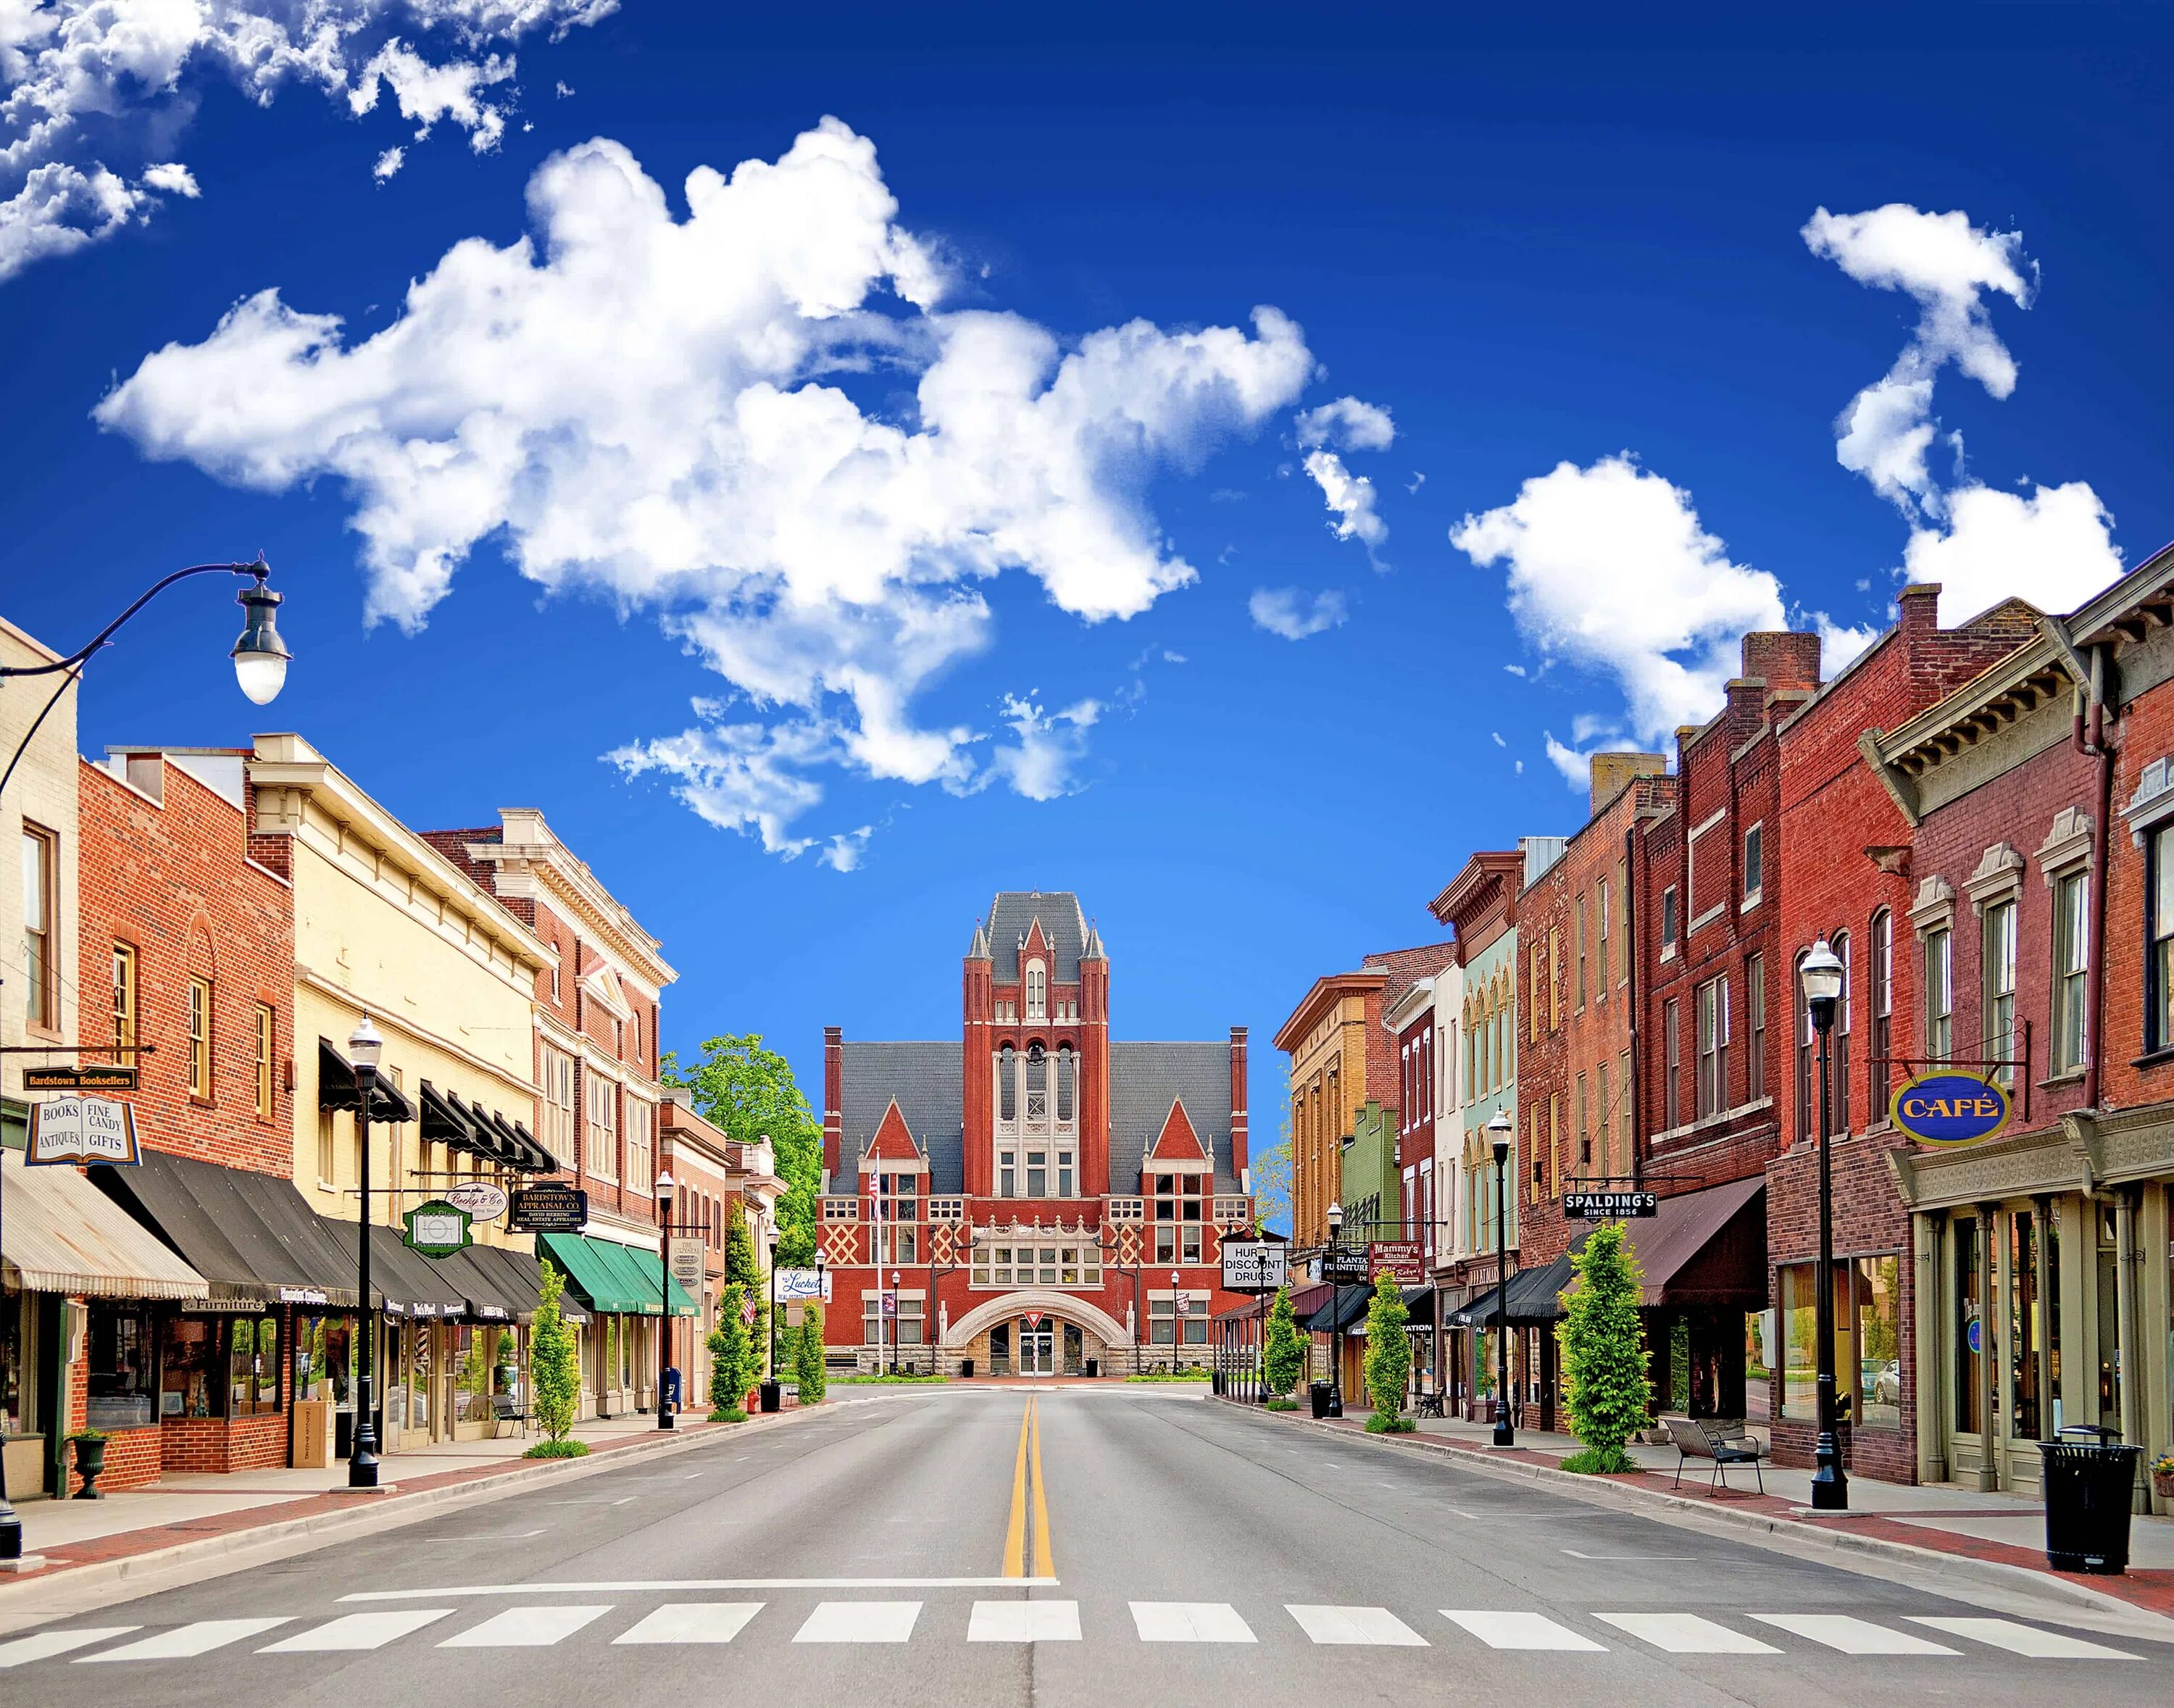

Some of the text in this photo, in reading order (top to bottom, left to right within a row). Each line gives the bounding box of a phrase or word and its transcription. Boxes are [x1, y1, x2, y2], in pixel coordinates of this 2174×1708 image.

[29, 1076, 130, 1086] Bardstown Booksellers
[43, 1104, 79, 1121] BOOKS
[88, 1104, 111, 1118] FINE
[1904, 1093, 1999, 1118] CAFÉ
[89, 1115, 122, 1131] CANDY
[39, 1131, 81, 1149] ANTIQUES
[89, 1134, 122, 1150] GIFTS
[451, 1193, 480, 1207] Becky
[480, 1195, 488, 1204] &
[1565, 1193, 1654, 1208] SPALDING'S
[1236, 1249, 1270, 1257] HURT
[1375, 1244, 1419, 1254] Mammy's
[1235, 1272, 1273, 1281] DRUGS
[196, 1299, 262, 1310] Furniture
